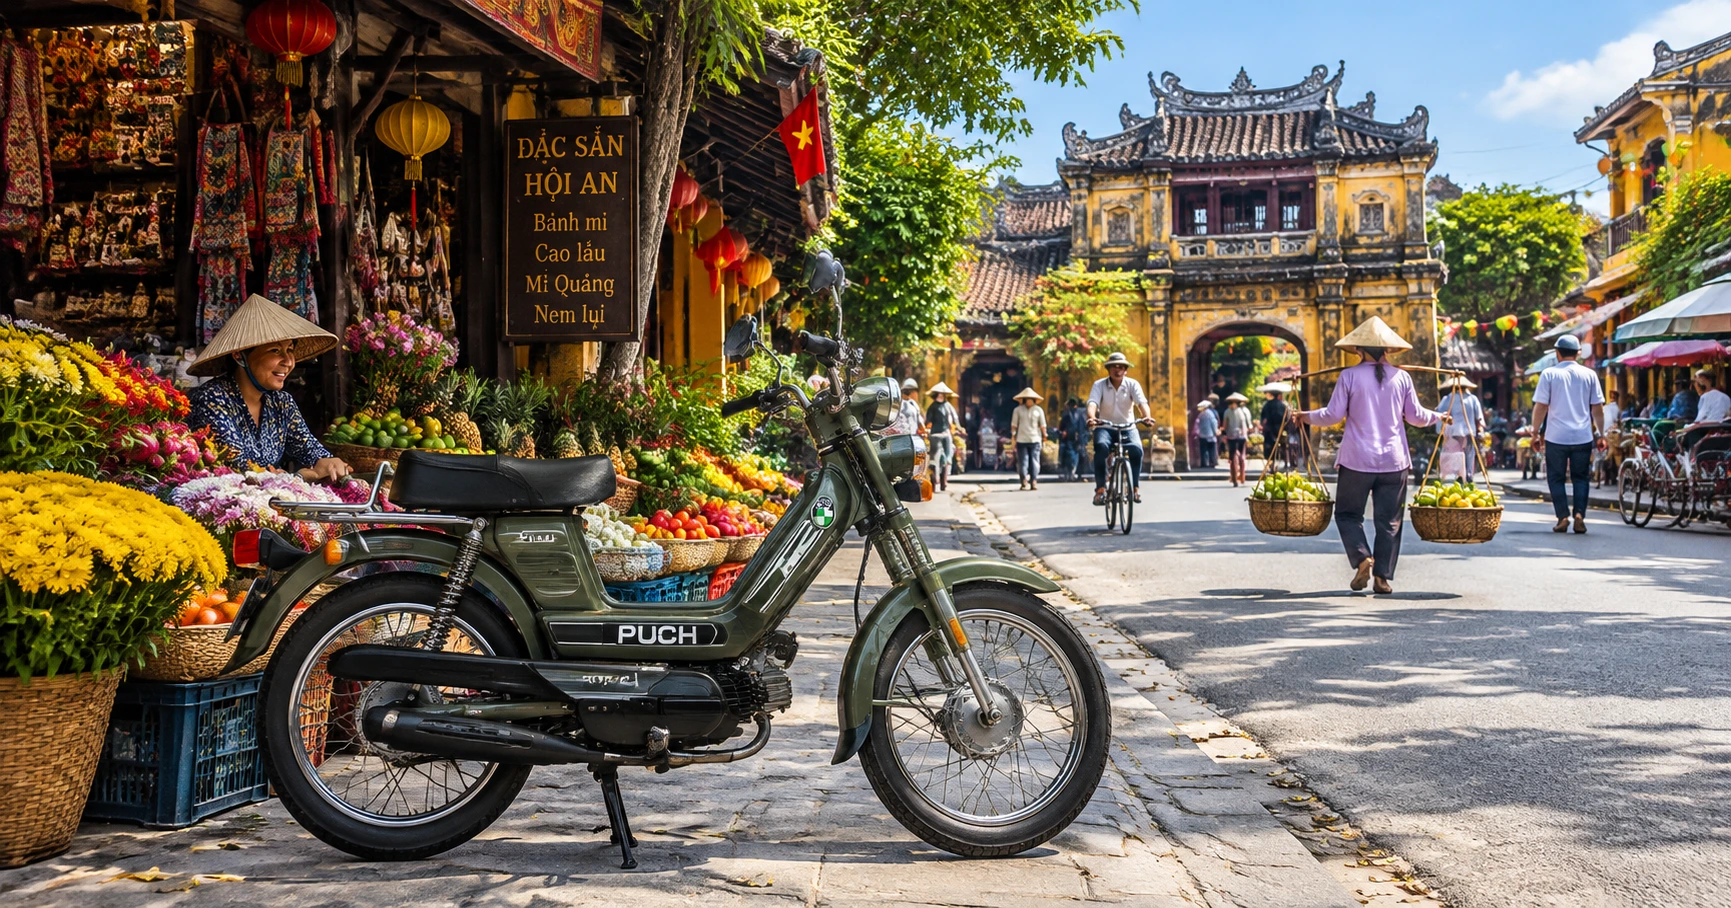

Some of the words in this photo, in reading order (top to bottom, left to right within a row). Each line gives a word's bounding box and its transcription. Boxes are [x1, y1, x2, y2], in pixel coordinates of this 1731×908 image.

[524, 166, 572, 203] HỘI
[579, 171, 618, 195] AN
[535, 243, 571, 263] Cao
[534, 304, 576, 324] Nem
[617, 624, 697, 645] PUCH
